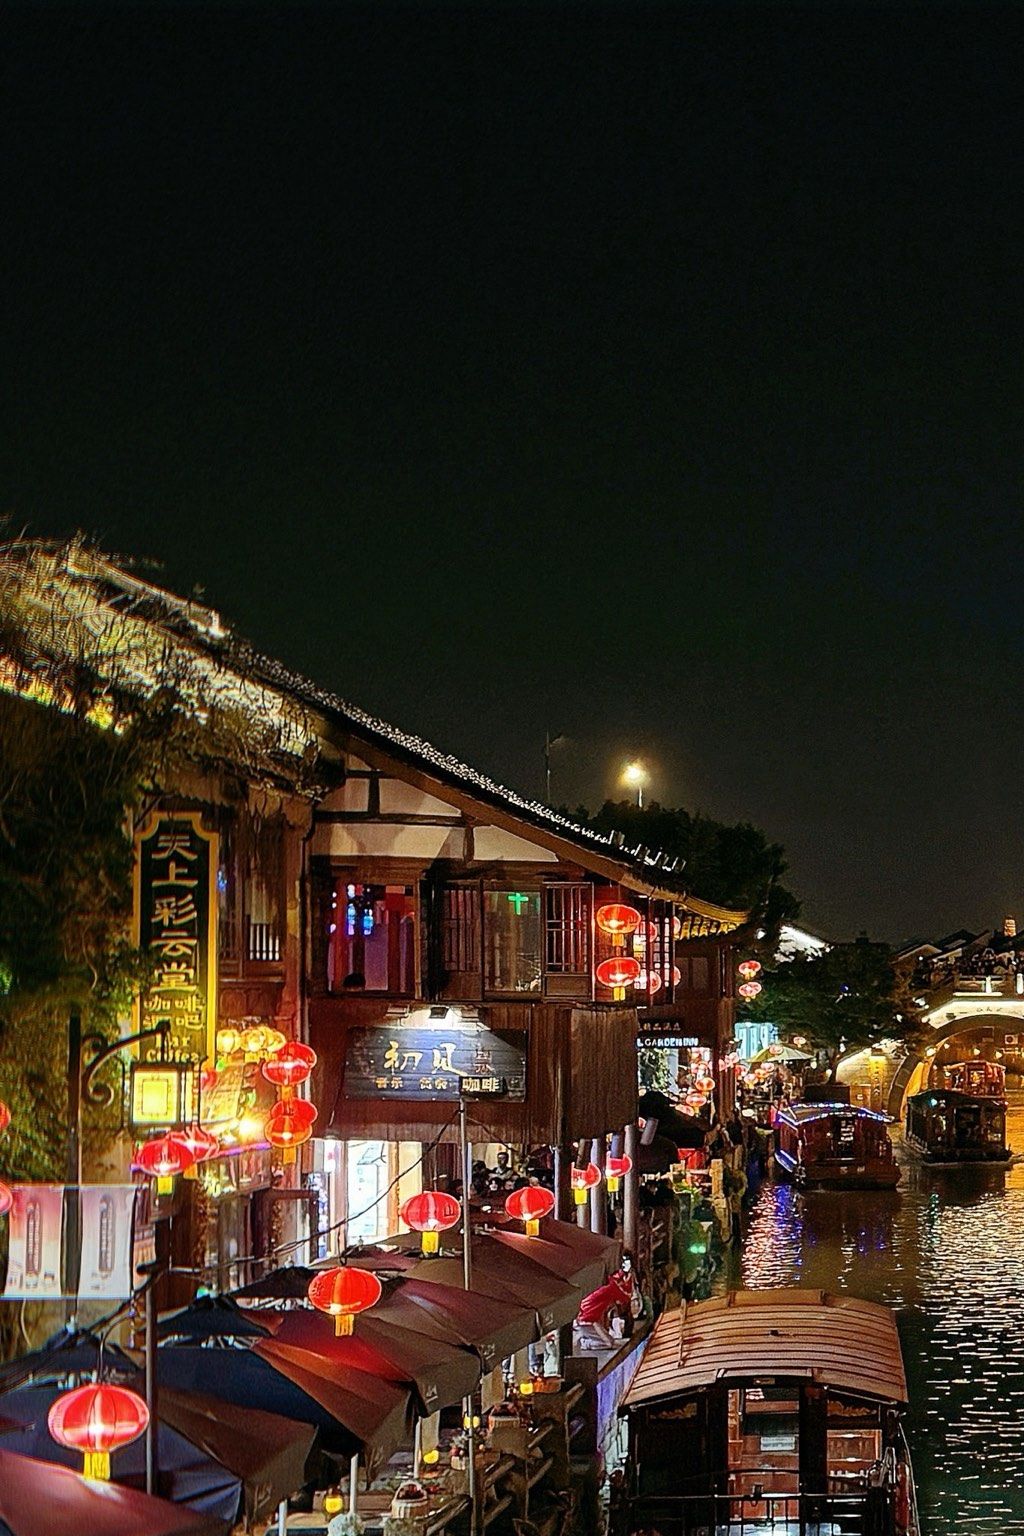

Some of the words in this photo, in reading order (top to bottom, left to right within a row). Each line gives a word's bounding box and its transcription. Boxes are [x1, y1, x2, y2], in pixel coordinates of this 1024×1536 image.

[151, 834, 199, 994] 天上彩云堂
[143, 995, 204, 1013] 咖啡
[462, 1077, 500, 1092] 咖啡
